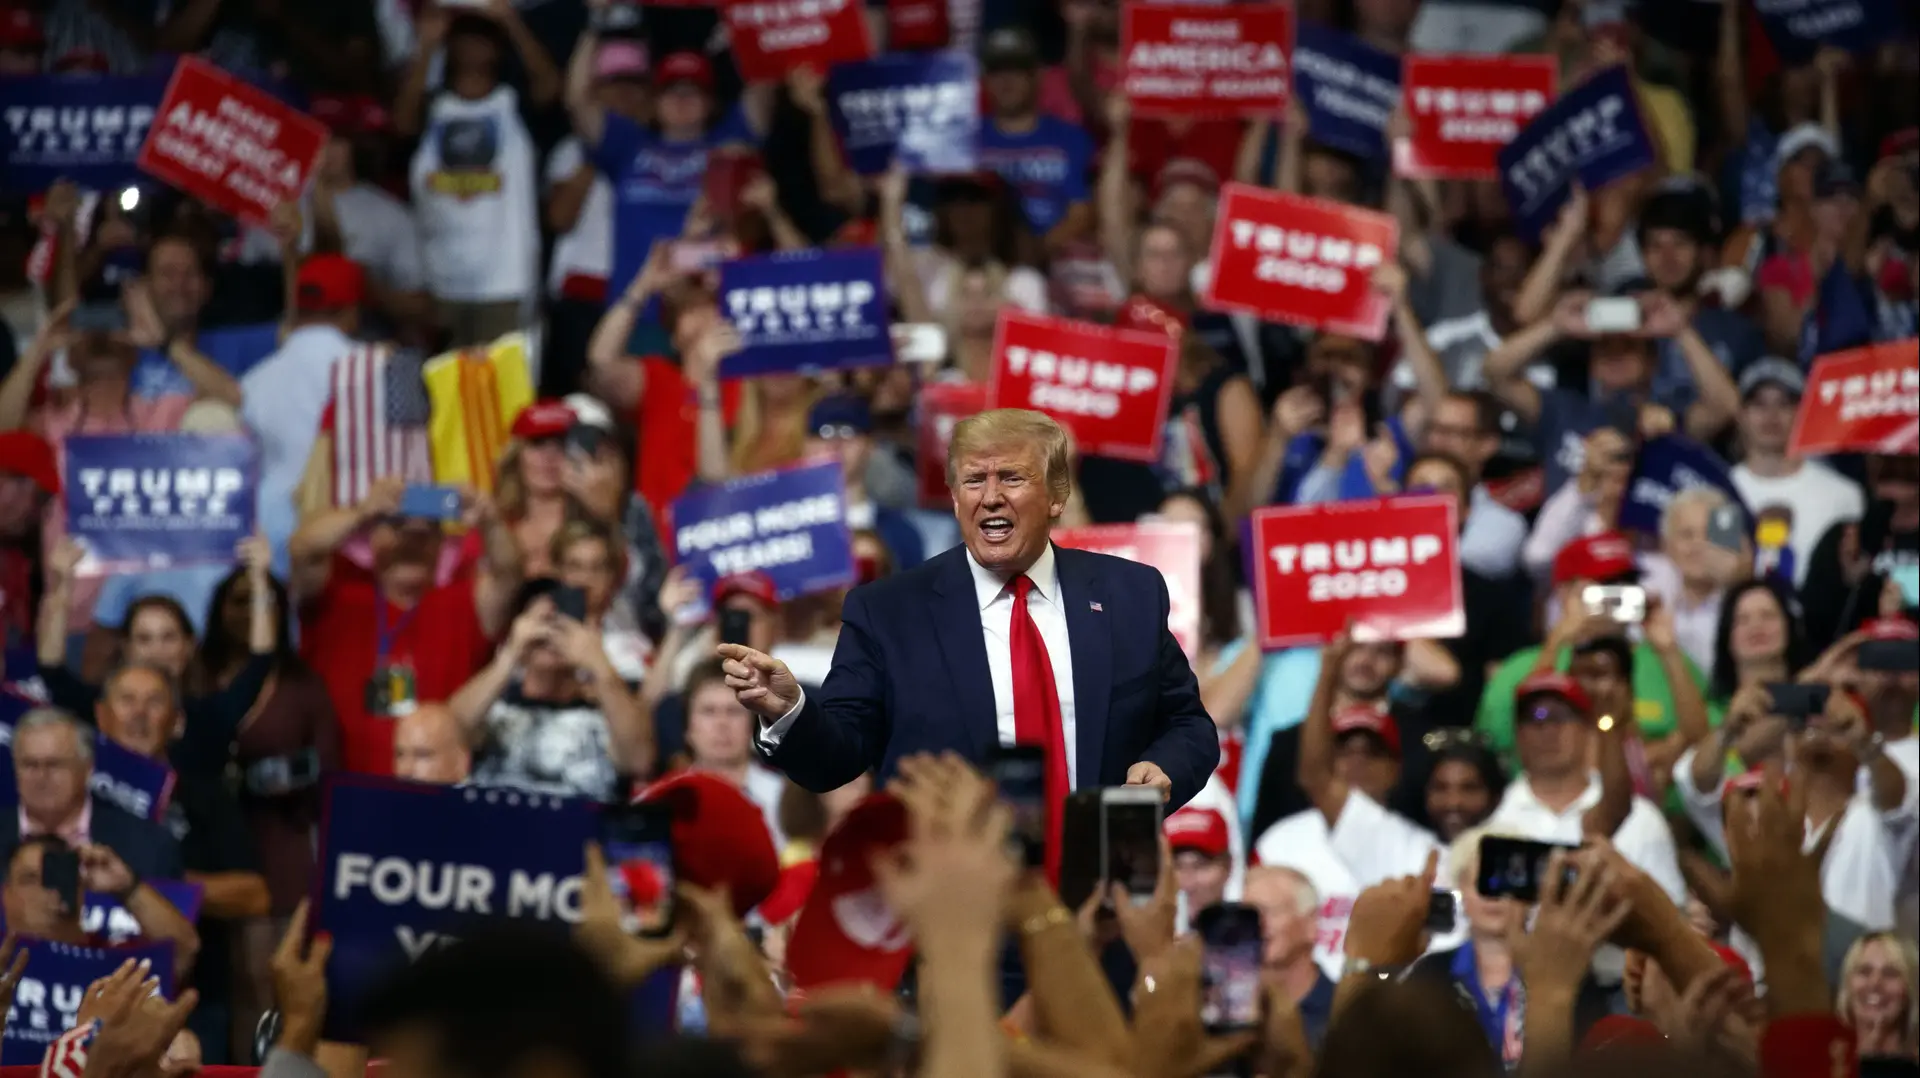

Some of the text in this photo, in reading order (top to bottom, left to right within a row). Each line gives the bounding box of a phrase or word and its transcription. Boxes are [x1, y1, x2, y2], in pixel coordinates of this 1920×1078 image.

[1170, 18, 1241, 40] MAKE
[1128, 40, 1287, 73] AMERICA
[1126, 76, 1289, 98] GREAT AGAIN
[1414, 87, 1545, 118] TRUMP
[3, 105, 155, 135] TRUMP
[1438, 118, 1518, 144] 2020
[156, 131, 226, 181] GREAT
[168, 100, 302, 188] AMERICA
[1230, 218, 1382, 270] TRUMP
[1255, 255, 1347, 294] 2020
[725, 280, 876, 317] TRUMP
[736, 310, 862, 334] PENCE
[1004, 344, 1159, 396] TRUMP
[1028, 381, 1121, 420] 2020
[79, 467, 243, 500] TRUMP
[93, 496, 227, 518] PENCE
[677, 493, 839, 556] FOUR MORE
[709, 530, 813, 577] YEARS!
[1270, 534, 1442, 574] TRUMP
[1307, 567, 1407, 602] 2020
[88, 771, 152, 820] ORE
[333, 852, 495, 915] FOUR
